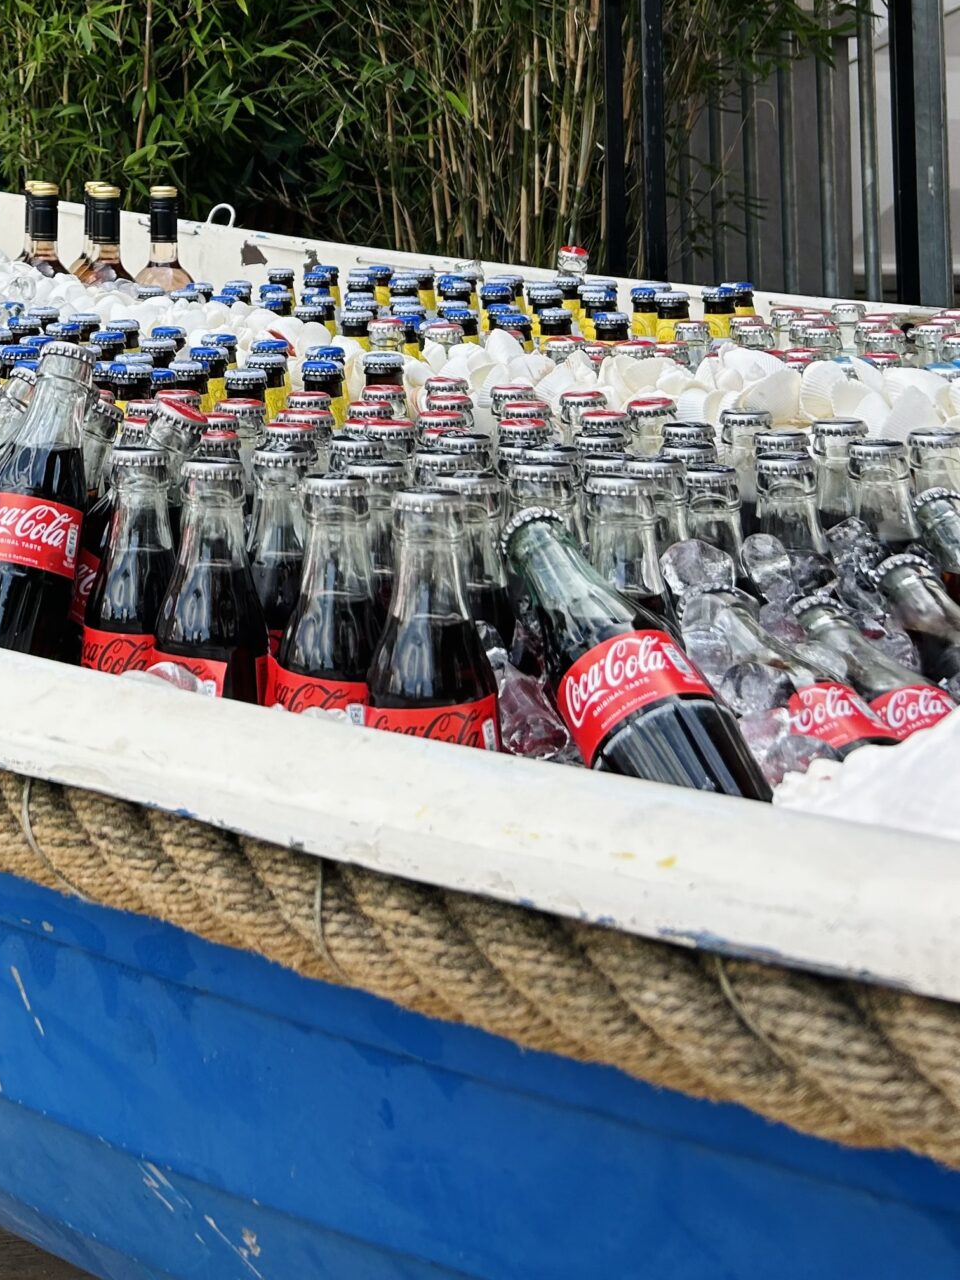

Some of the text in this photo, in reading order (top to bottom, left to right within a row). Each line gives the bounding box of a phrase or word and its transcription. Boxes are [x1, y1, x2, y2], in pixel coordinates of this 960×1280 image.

[21, 541, 42, 552] TASTE
[566, 635, 666, 729] Coca-Cola
[625, 676, 651, 690] TASTE
